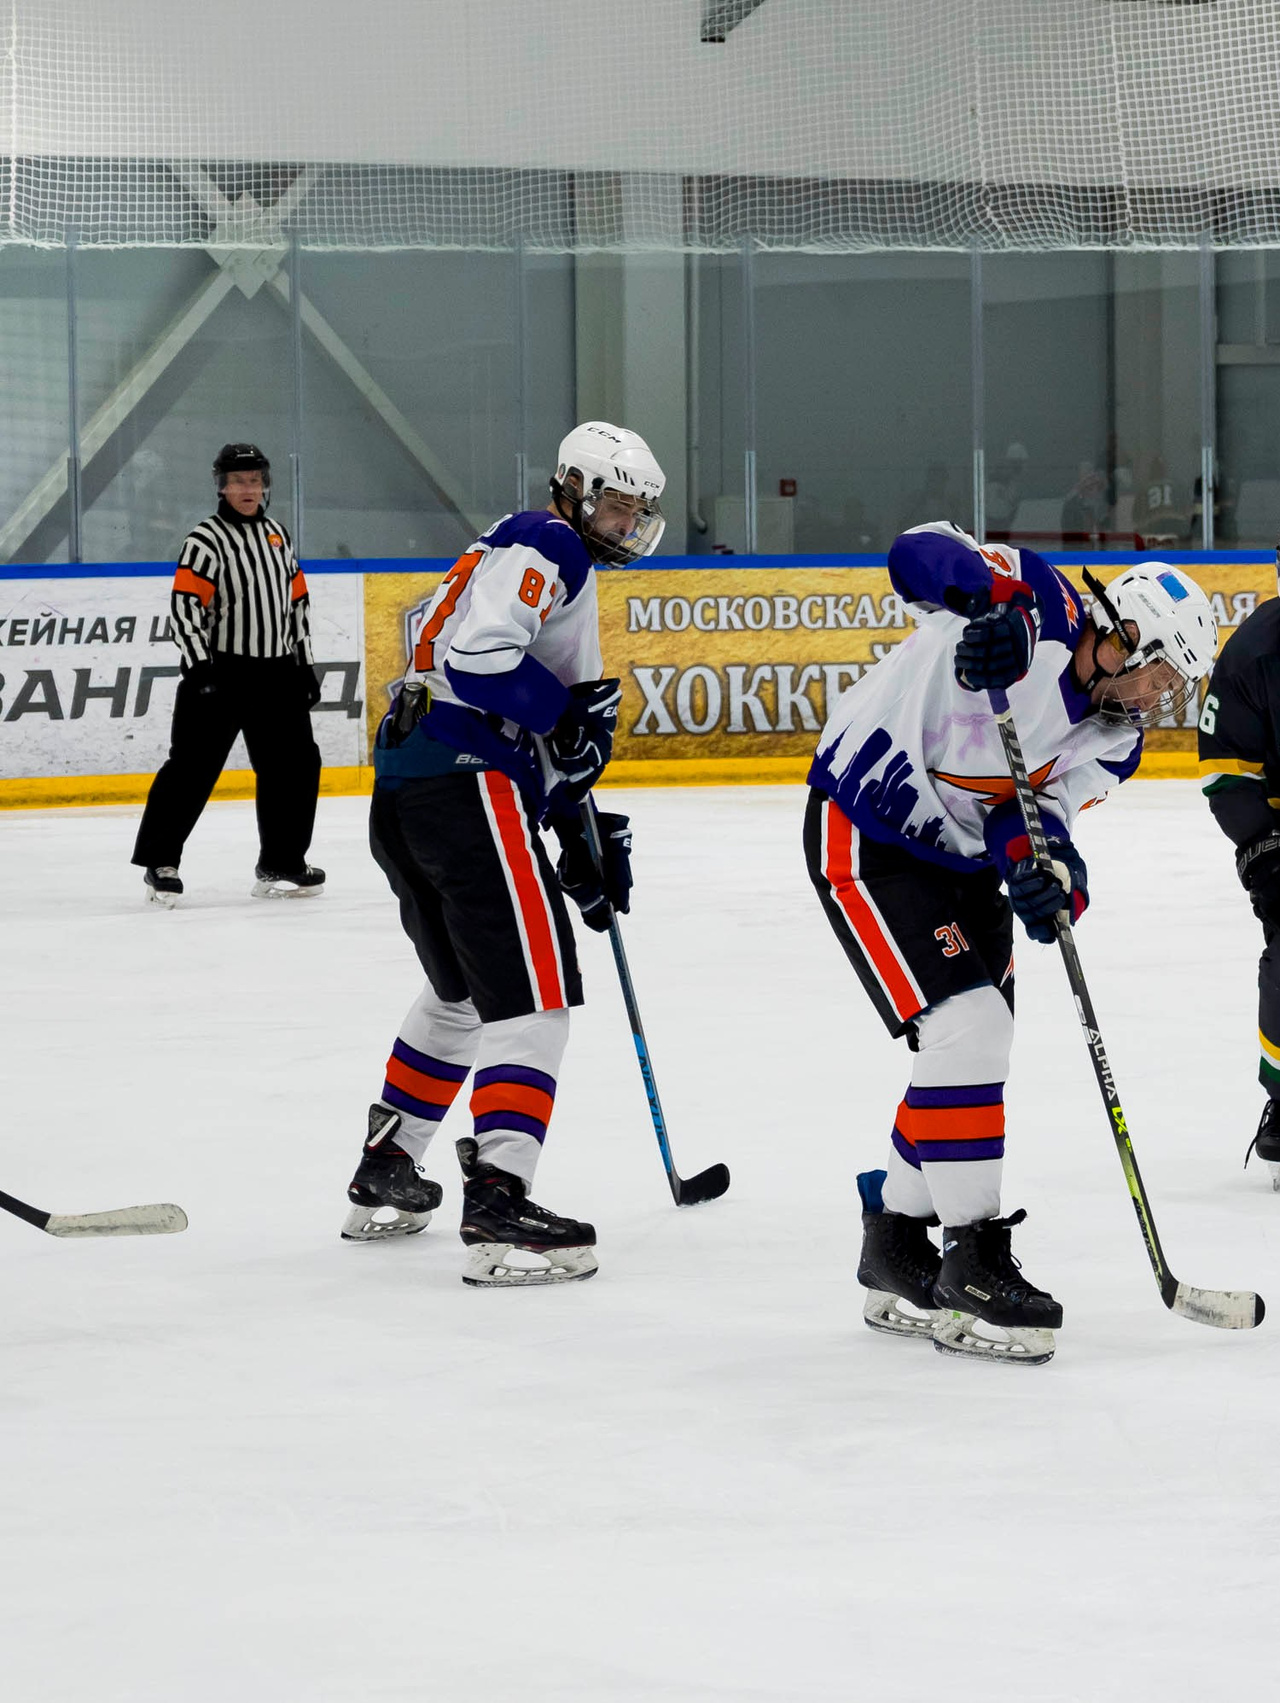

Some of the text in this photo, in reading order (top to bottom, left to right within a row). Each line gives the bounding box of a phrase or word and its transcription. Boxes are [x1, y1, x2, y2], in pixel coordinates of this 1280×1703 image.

[587, 427, 621, 443] CCM
[0, 612, 137, 646] ЕЙНАЯ
[628, 595, 905, 632] МОСКОВСКАЯ
[934, 921, 970, 958] 31
[1089, 1028, 1118, 1101] ALPHA
